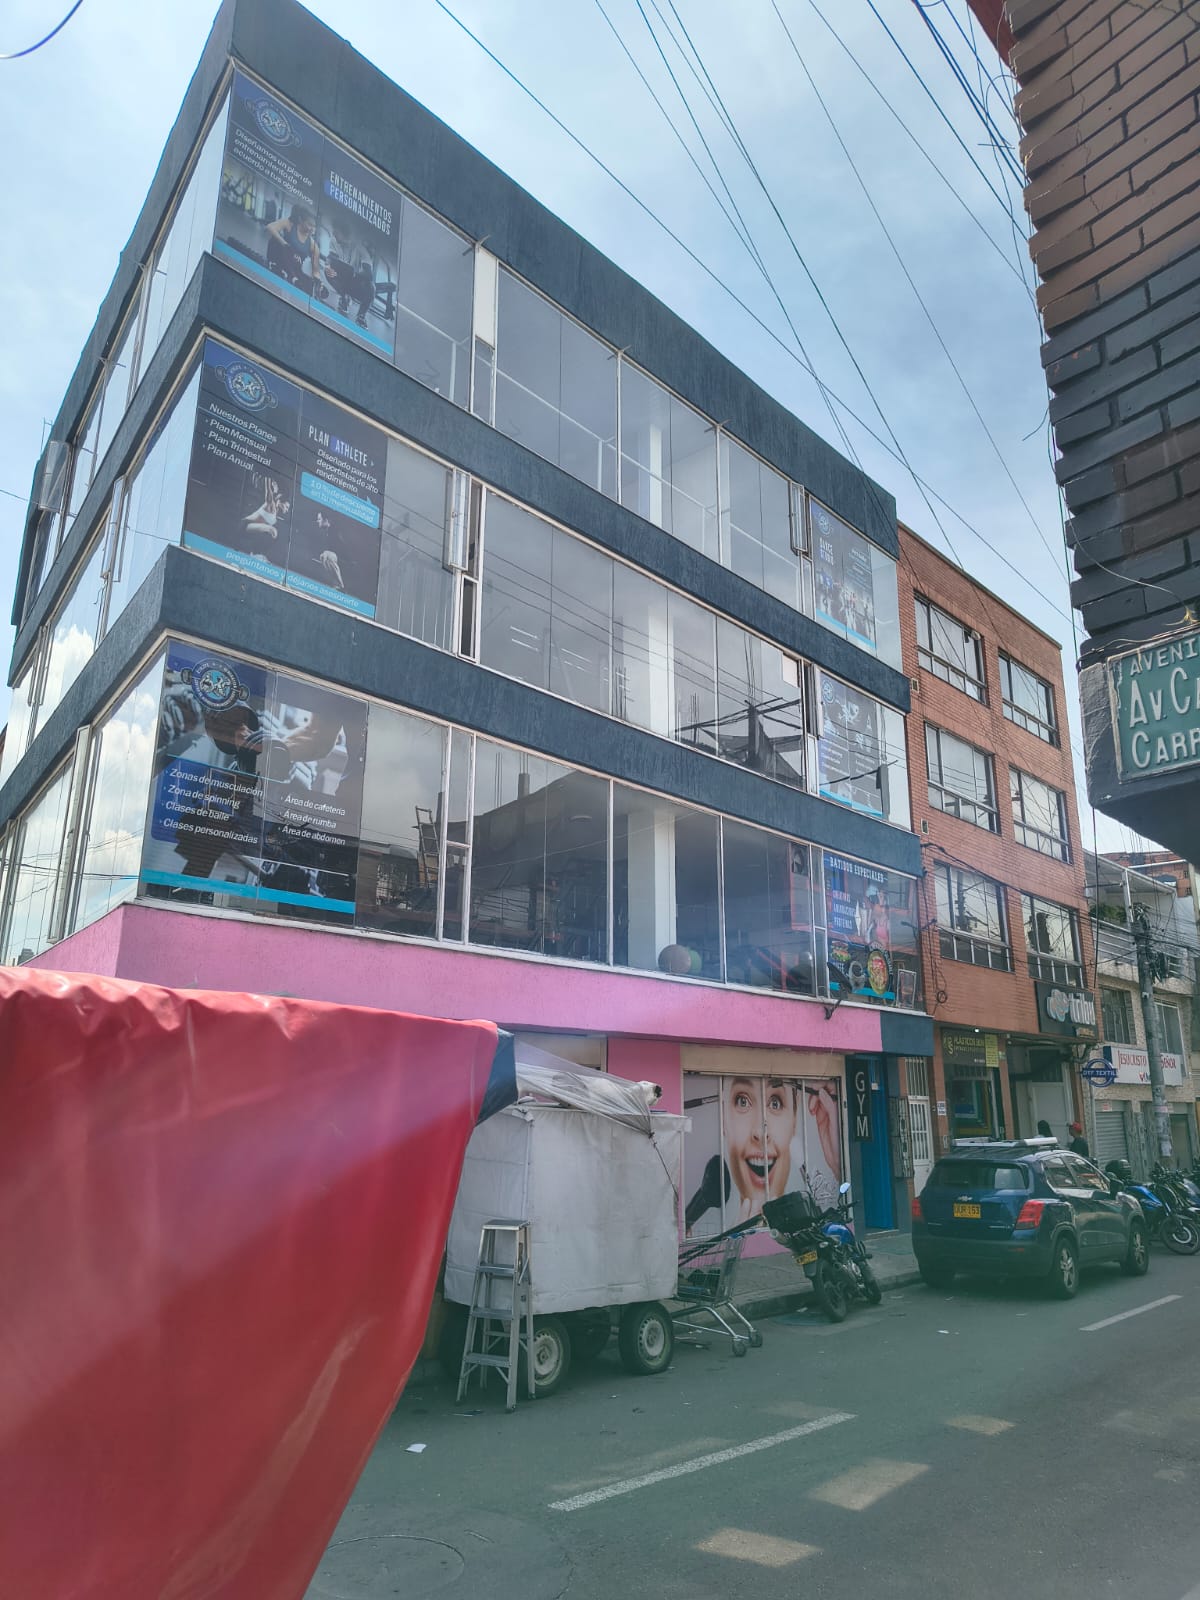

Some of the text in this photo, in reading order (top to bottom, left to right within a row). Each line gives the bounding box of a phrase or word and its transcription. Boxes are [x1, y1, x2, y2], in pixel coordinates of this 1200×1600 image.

[234, 139, 298, 185] entrenamiento de
[235, 128, 313, 187] Diseñamos un plan de
[233, 147, 265, 171] acuerdo
[270, 172, 282, 184] tus
[282, 181, 313, 205] objetivos
[329, 183, 391, 236] PERSONALIZADOS
[330, 170, 392, 224] ENTRENAMIENTOS
[209, 403, 277, 443] Nuestros Planes
[209, 418, 268, 453] Plan Mensual
[207, 443, 254, 471] Plan Anual
[208, 430, 272, 467] Plan Trimestral
[308, 425, 368, 467] PLAN ATHLETE
[315, 468, 358, 493] rendimiento
[316, 458, 379, 494] deportistas de alto
[317, 448, 377, 484] Diseñado para los
[168, 784, 241, 809] Zona de spinning
[169, 768, 264, 797] Zonas de musculación
[165, 800, 230, 822] Clases de baile
[283, 808, 337, 829] Área de rumba
[303, 800, 314, 809] de
[163, 818, 258, 844] Clases personalizadas
[281, 823, 346, 846] Área de abdomen
[854, 864, 884, 883] ESPECIALES
[855, 1071, 869, 1137] GYM
